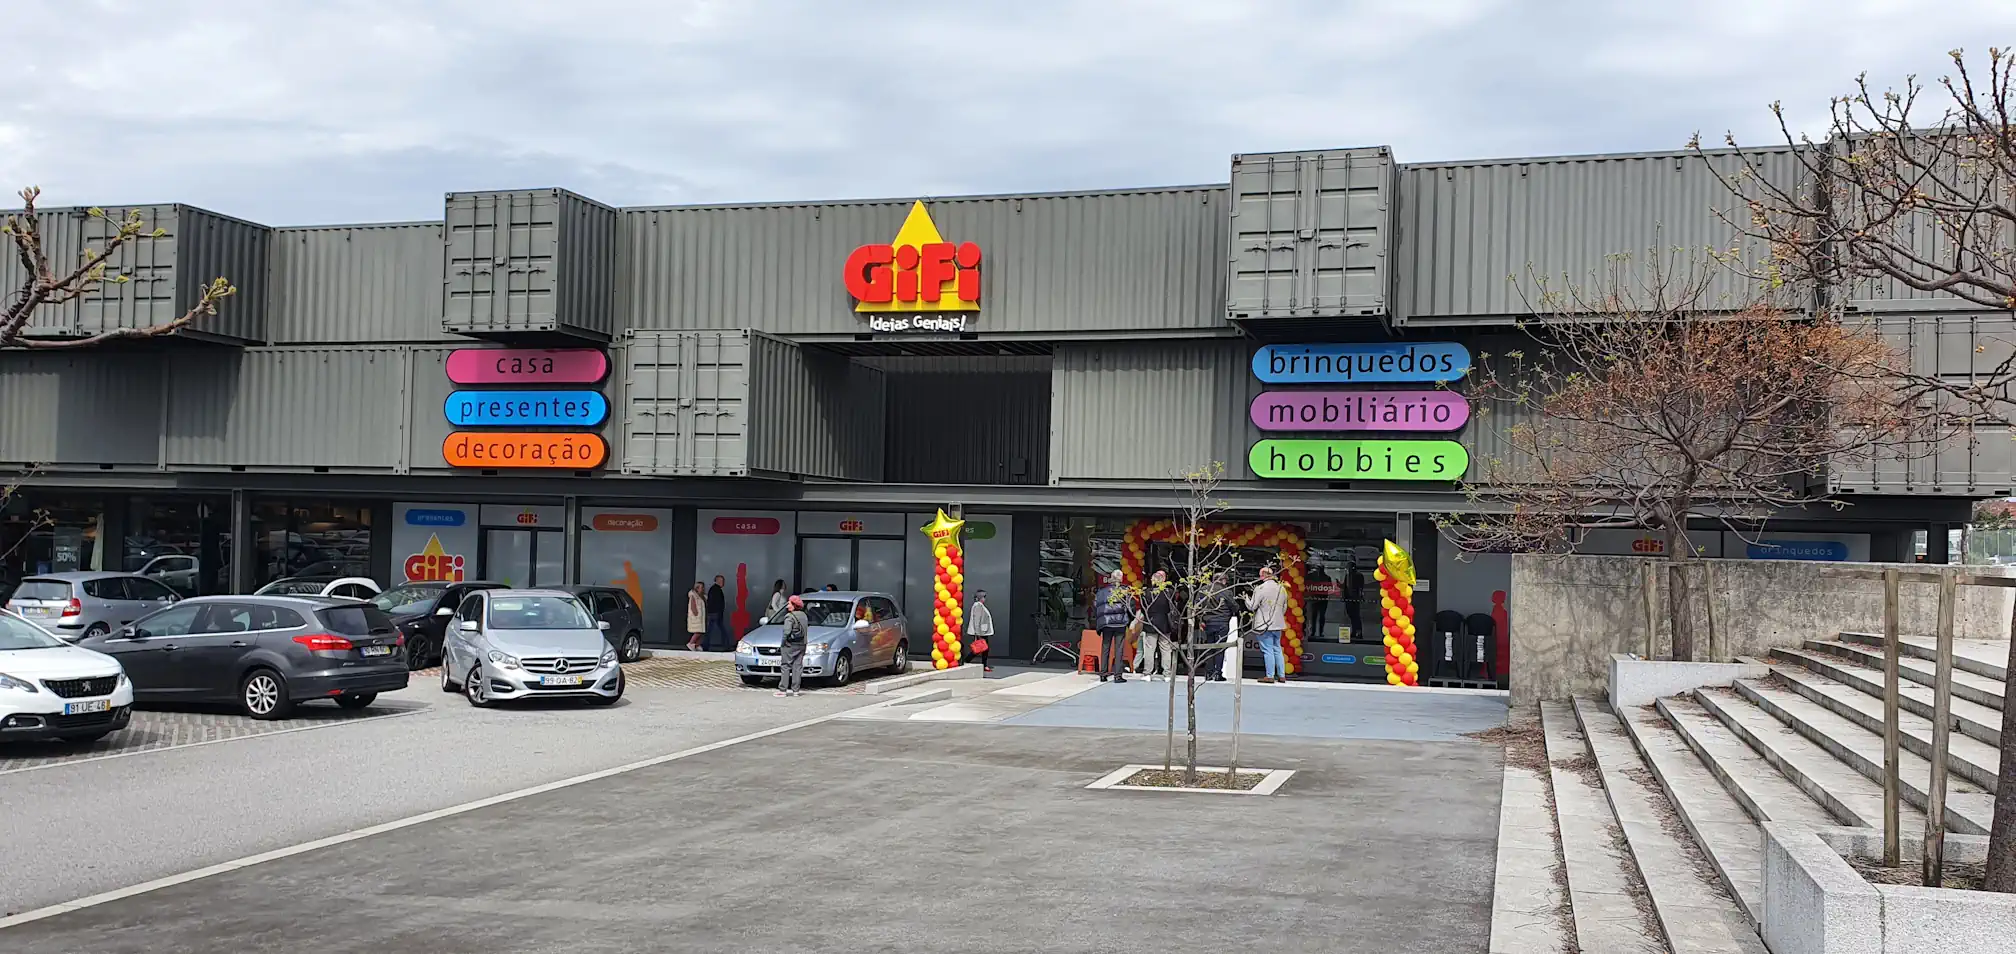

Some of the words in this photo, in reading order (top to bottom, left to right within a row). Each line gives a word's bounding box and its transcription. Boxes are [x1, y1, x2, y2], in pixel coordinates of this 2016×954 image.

[843, 241, 982, 303] GiFi
[869, 314, 910, 332] Ideias
[912, 314, 967, 332] Geniais!
[496, 357, 554, 374] casa
[1269, 346, 1453, 380] brinquedos
[460, 397, 591, 423] presentes
[1268, 396, 1452, 424] mobiliário
[455, 436, 592, 465] decoração
[1269, 446, 1446, 474] hobbies
[517, 513, 538, 524] GiFi
[735, 522, 757, 530] casa
[839, 520, 863, 531] GiFi
[1631, 539, 1664, 552] GiFi
[56, 552, 77, 562] 50%
[404, 554, 465, 583] GiFi
[1304, 584, 1336, 592] vindos!
